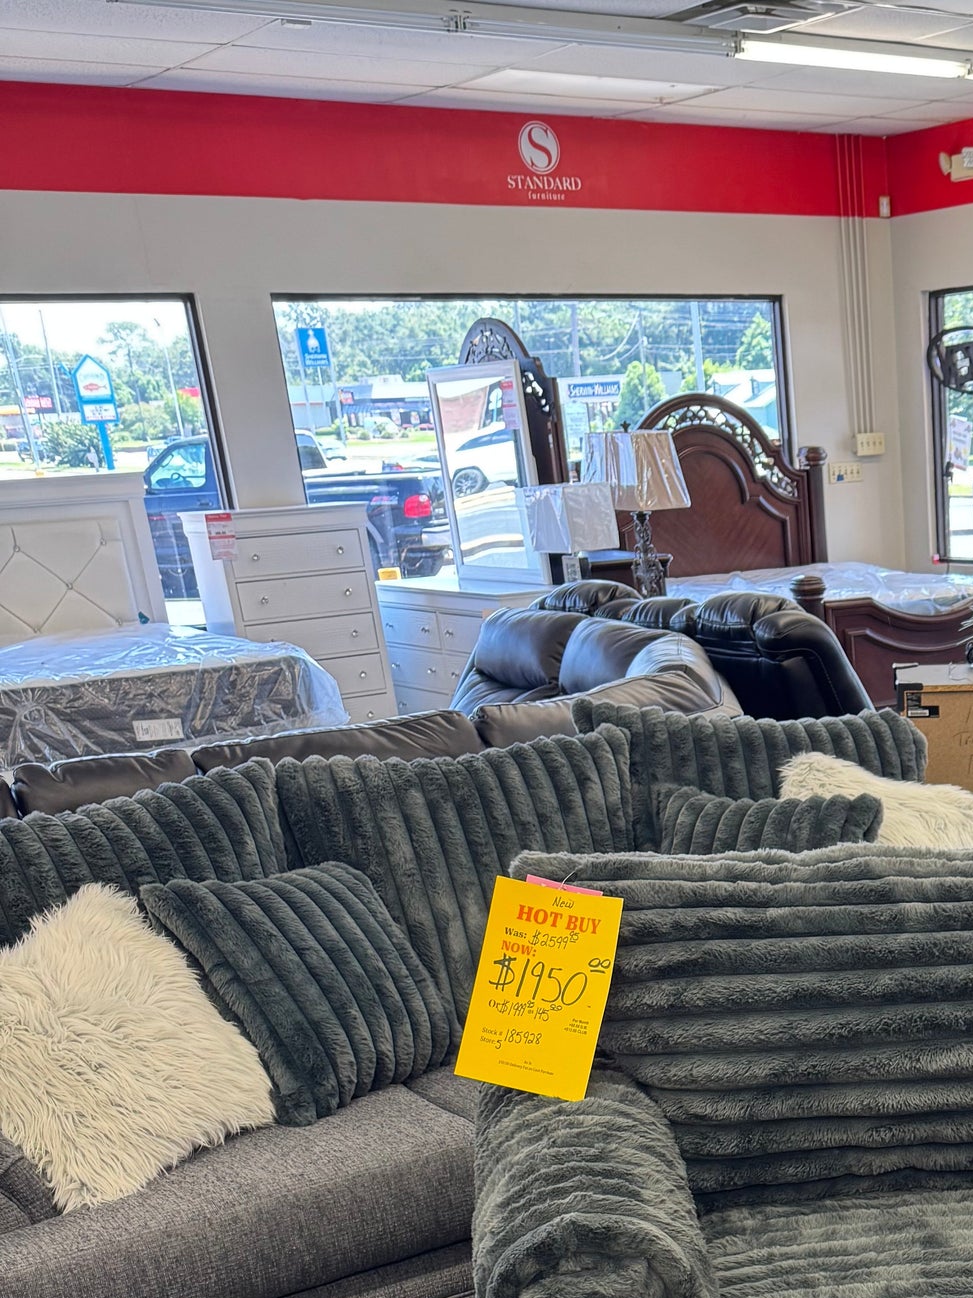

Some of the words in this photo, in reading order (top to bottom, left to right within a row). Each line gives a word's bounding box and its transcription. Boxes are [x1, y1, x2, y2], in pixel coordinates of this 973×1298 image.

[507, 175, 582, 191] STANDARD
[528, 191, 565, 201] furniture
[552, 896, 575, 909] New
[516, 904, 563, 928] HOT
[565, 914, 602, 934] BUY
[504, 926, 527, 939] Was:
[501, 939, 537, 957] NOW:
[481, 1027, 498, 1036] Stock
[504, 1028, 543, 1045] 185928
